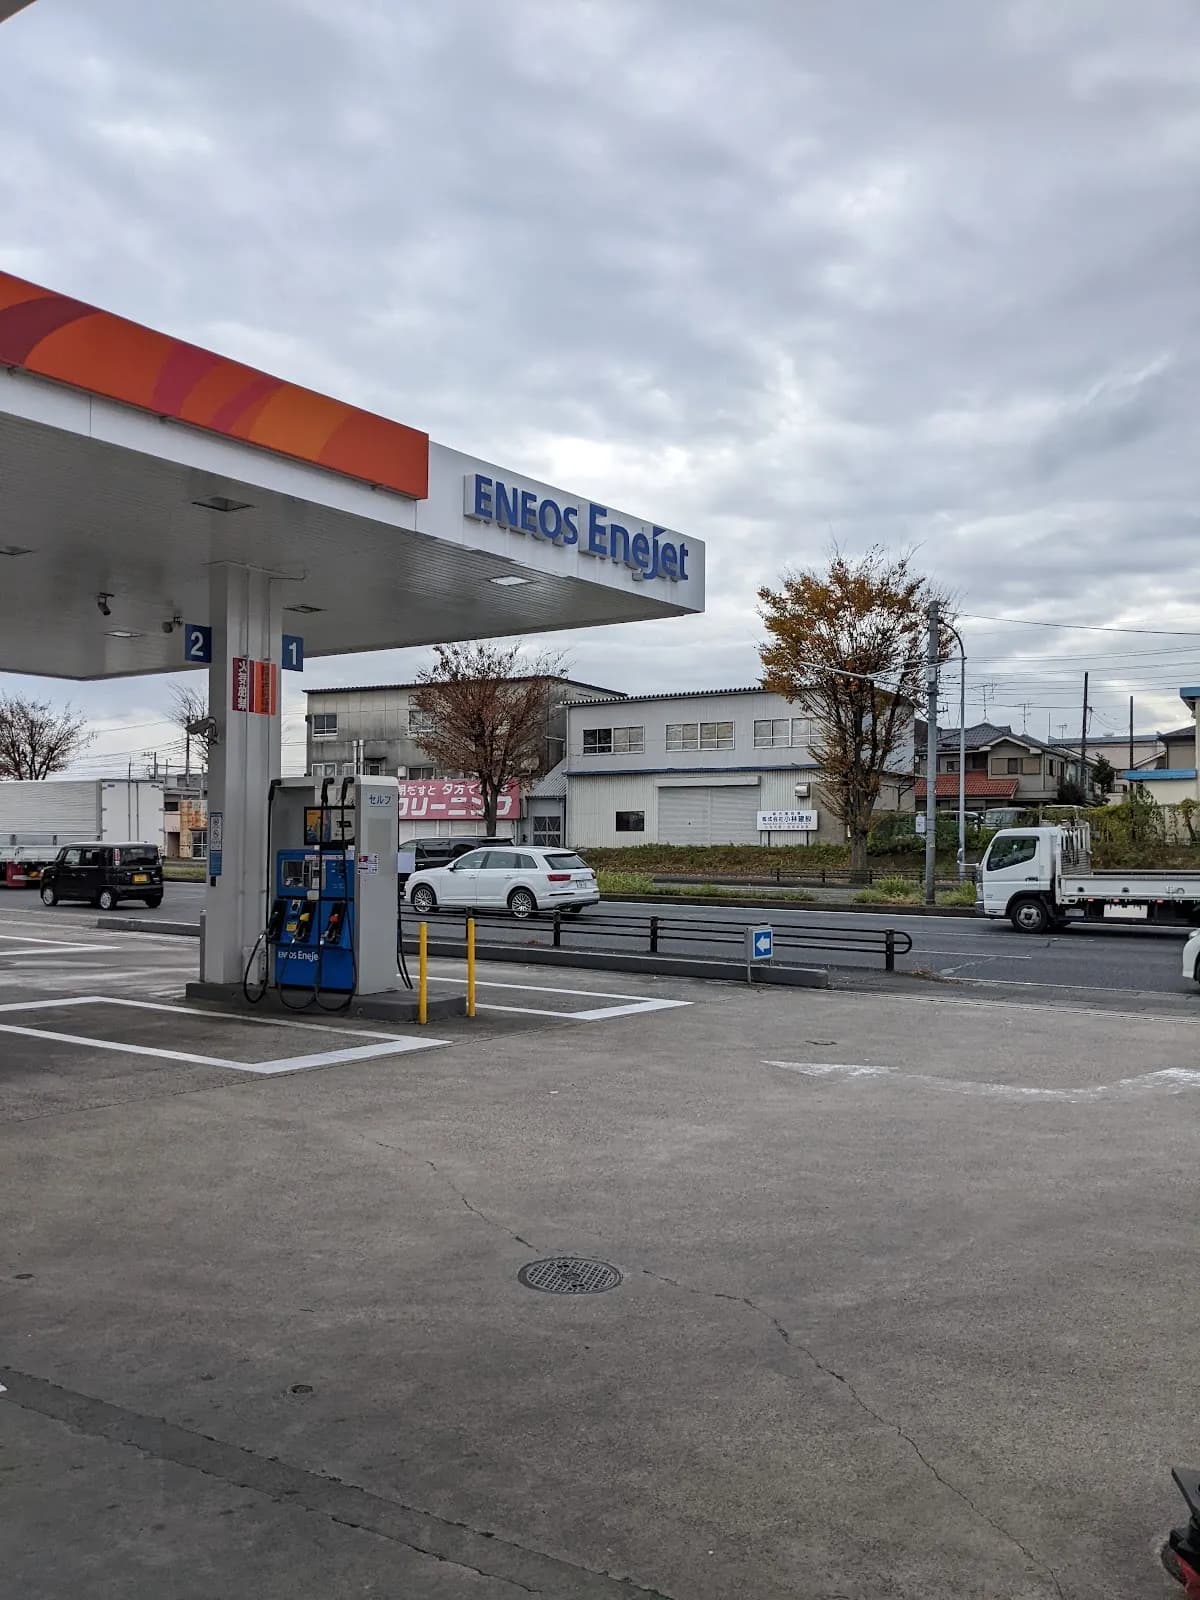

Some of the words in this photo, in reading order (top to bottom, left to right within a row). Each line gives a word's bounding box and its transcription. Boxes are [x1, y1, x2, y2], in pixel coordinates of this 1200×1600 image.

[474, 473, 579, 545] ENEOS
[588, 502, 689, 580] Enejet
[190, 631, 205, 657] 2
[288, 641, 298, 666] 1
[368, 794, 391, 805] セルフ
[278, 951, 297, 960] ENOS
[298, 951, 319, 962] Eneje
